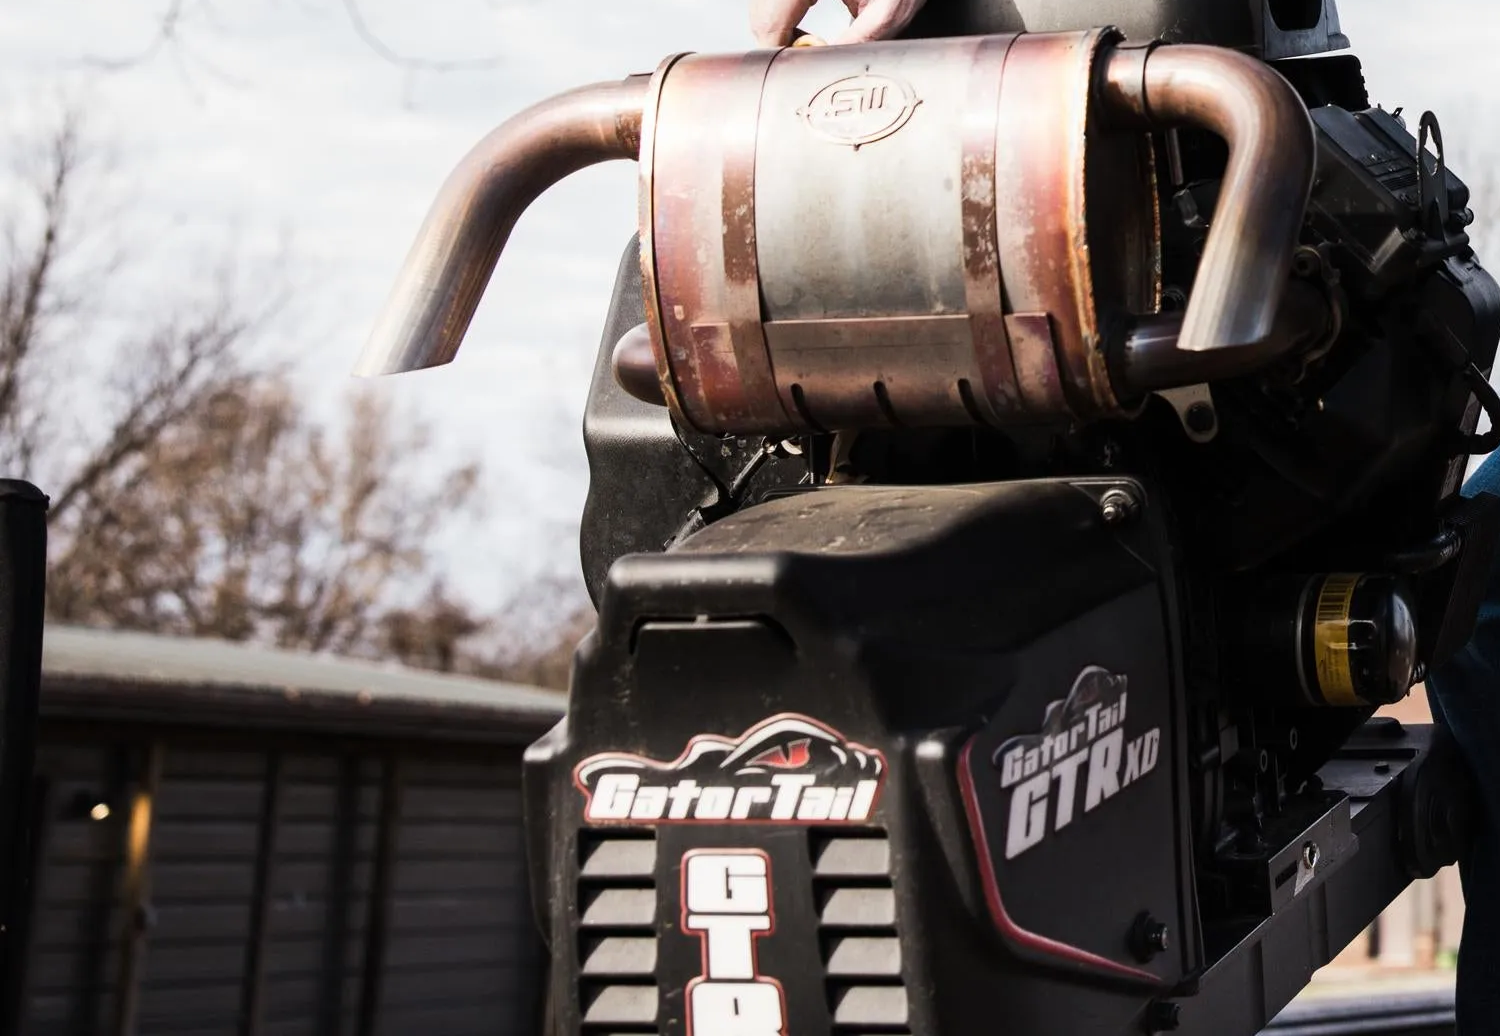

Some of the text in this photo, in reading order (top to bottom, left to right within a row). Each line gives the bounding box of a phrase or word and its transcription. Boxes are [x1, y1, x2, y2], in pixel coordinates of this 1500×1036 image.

[1004, 727, 1161, 861] GTR XD
[687, 854, 783, 1036] GTR
